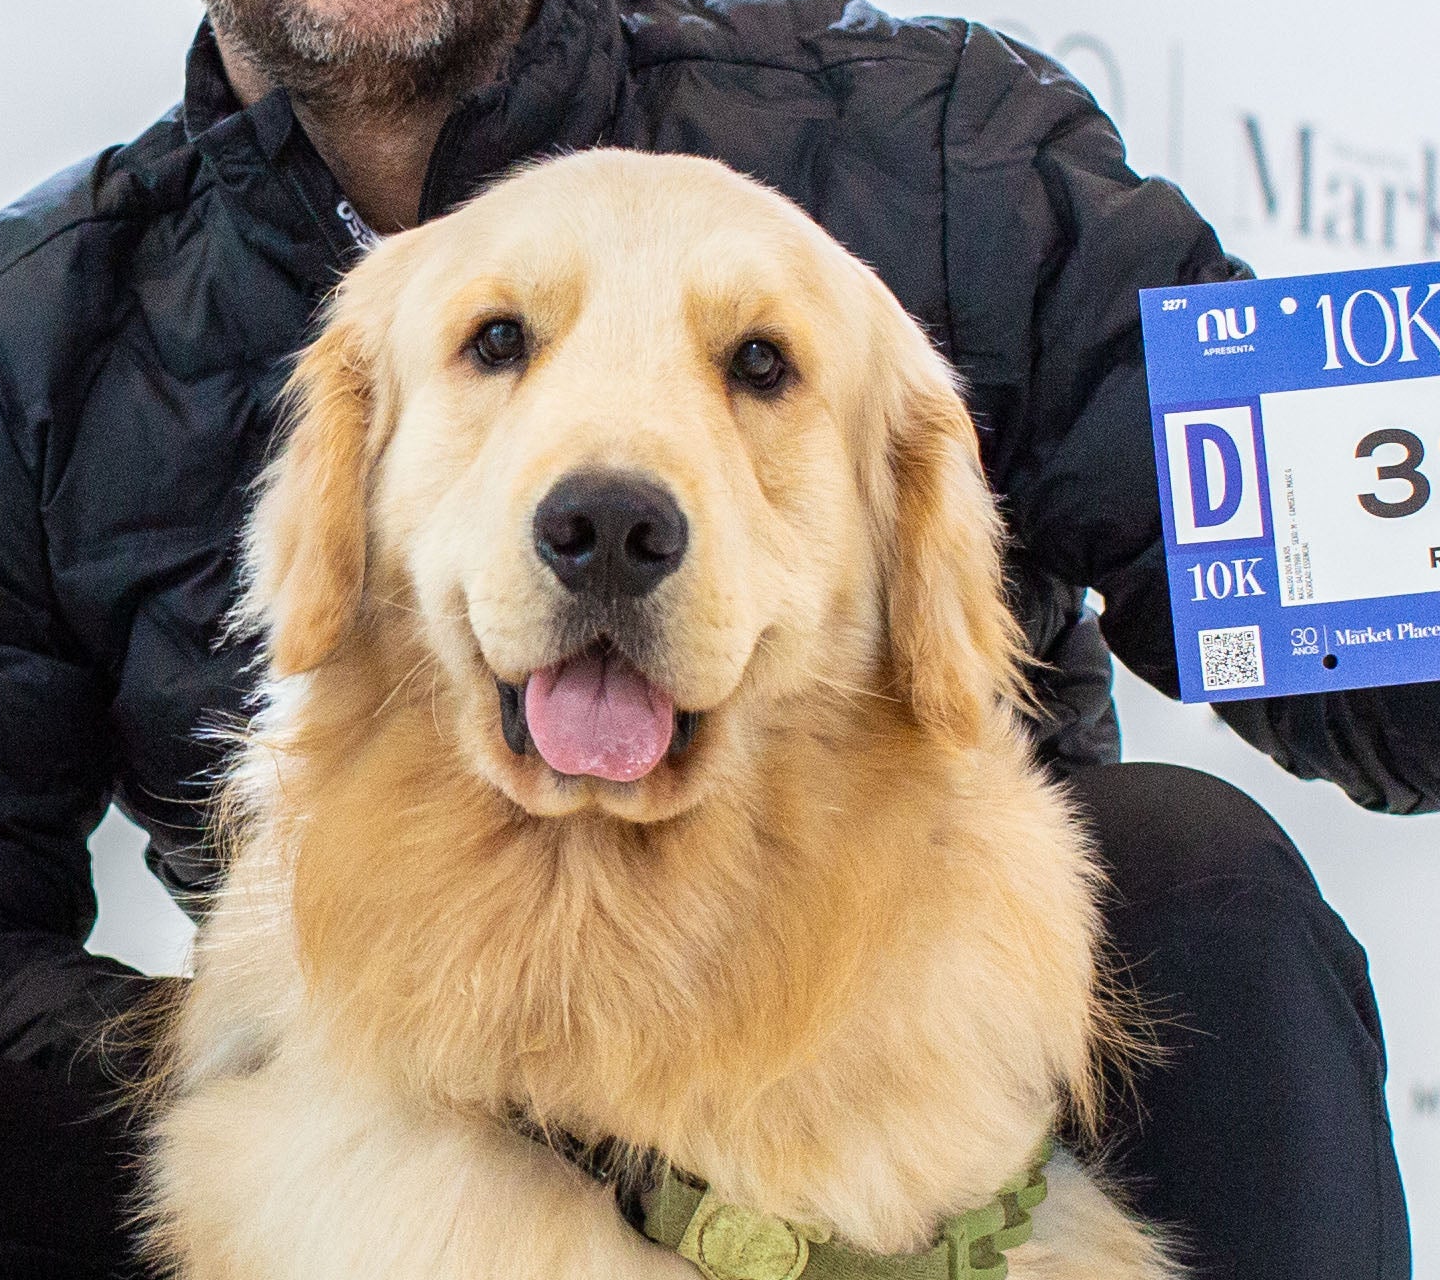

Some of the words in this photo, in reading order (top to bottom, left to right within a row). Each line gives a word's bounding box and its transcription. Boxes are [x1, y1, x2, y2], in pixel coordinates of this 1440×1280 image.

[1161, 297, 1189, 312] 3271
[1196, 305, 1258, 343] nu
[1202, 344, 1257, 357] APRESENTA
[1184, 422, 1244, 530] D
[1187, 557, 1267, 602] 10K
[1291, 627, 1318, 647] 30
[1334, 627, 1393, 647] Market
[1292, 646, 1319, 656] ANOS
